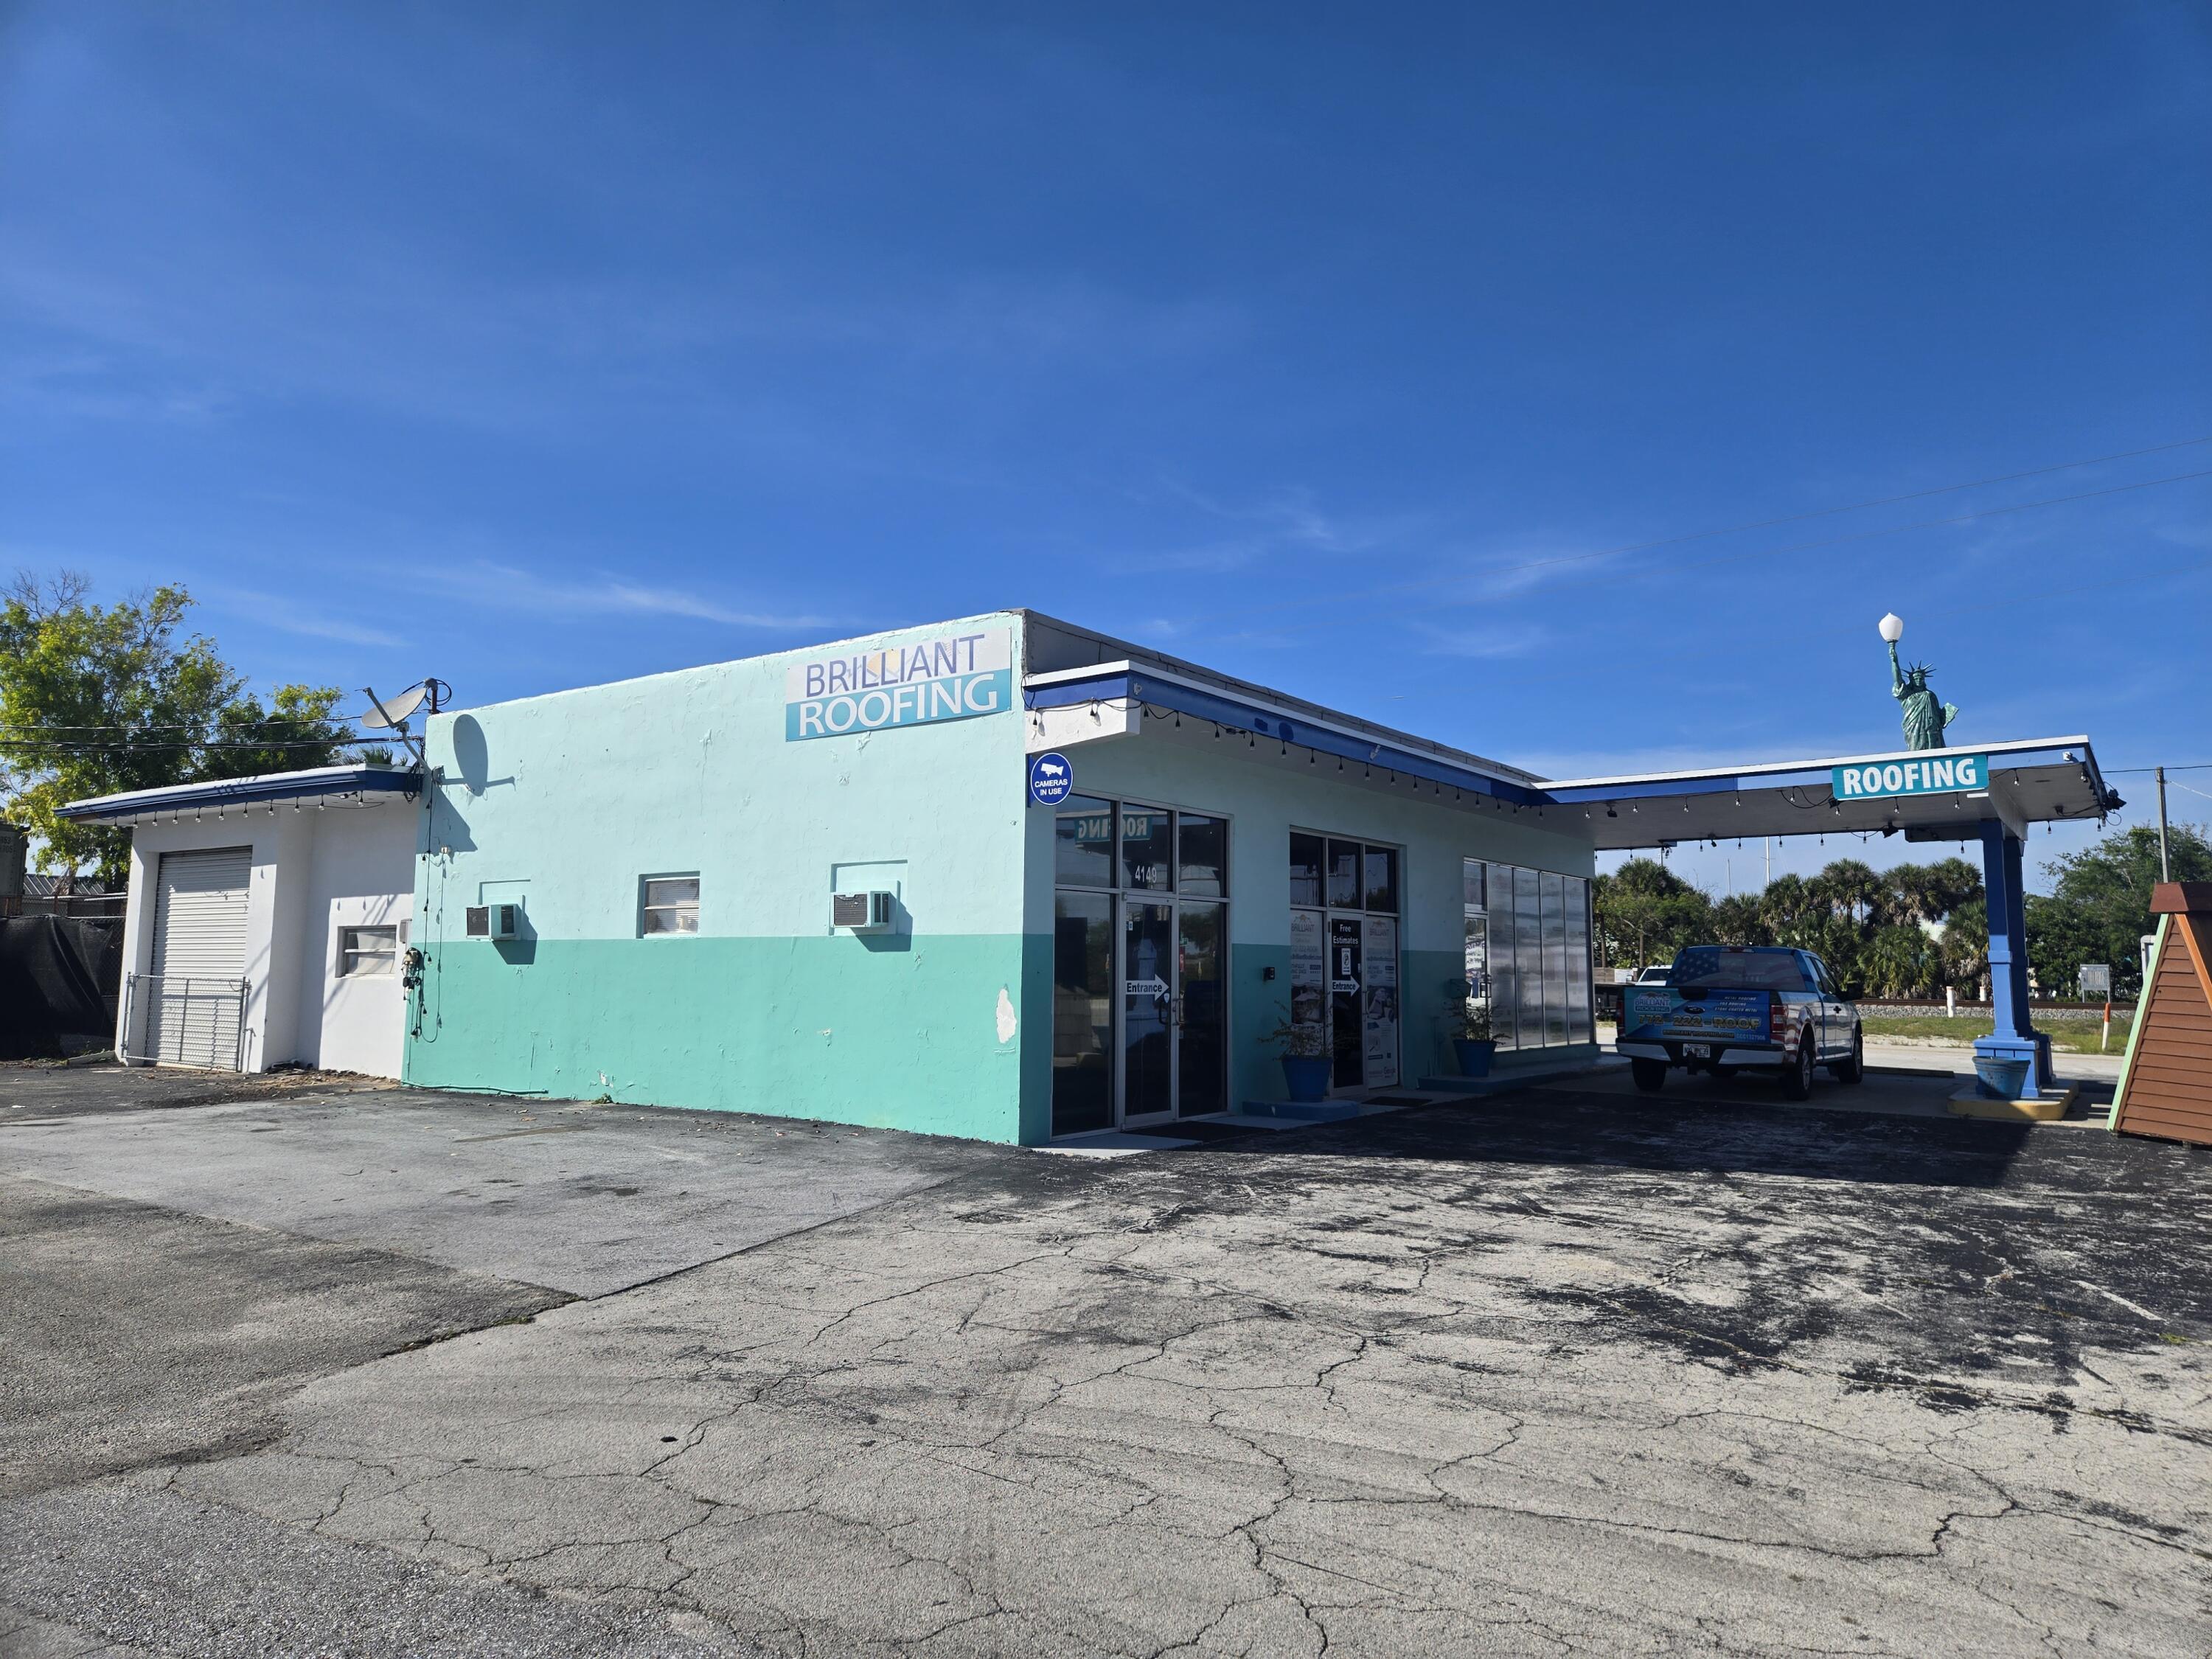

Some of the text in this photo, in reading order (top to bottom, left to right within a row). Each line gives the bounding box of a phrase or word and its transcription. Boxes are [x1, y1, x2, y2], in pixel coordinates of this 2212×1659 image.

[807, 634, 985, 698] BRILLIANT
[799, 673, 998, 737] ROOFING
[1843, 758, 1977, 795] ROOFING
[1034, 779, 1068, 787] CAMERAS
[1135, 865, 1157, 883] 4149
[1340, 924, 1352, 932] Free
[1332, 936, 1359, 945] Estimates
[1127, 982, 1163, 993] Entrance
[1332, 981, 1356, 990] Entrance
